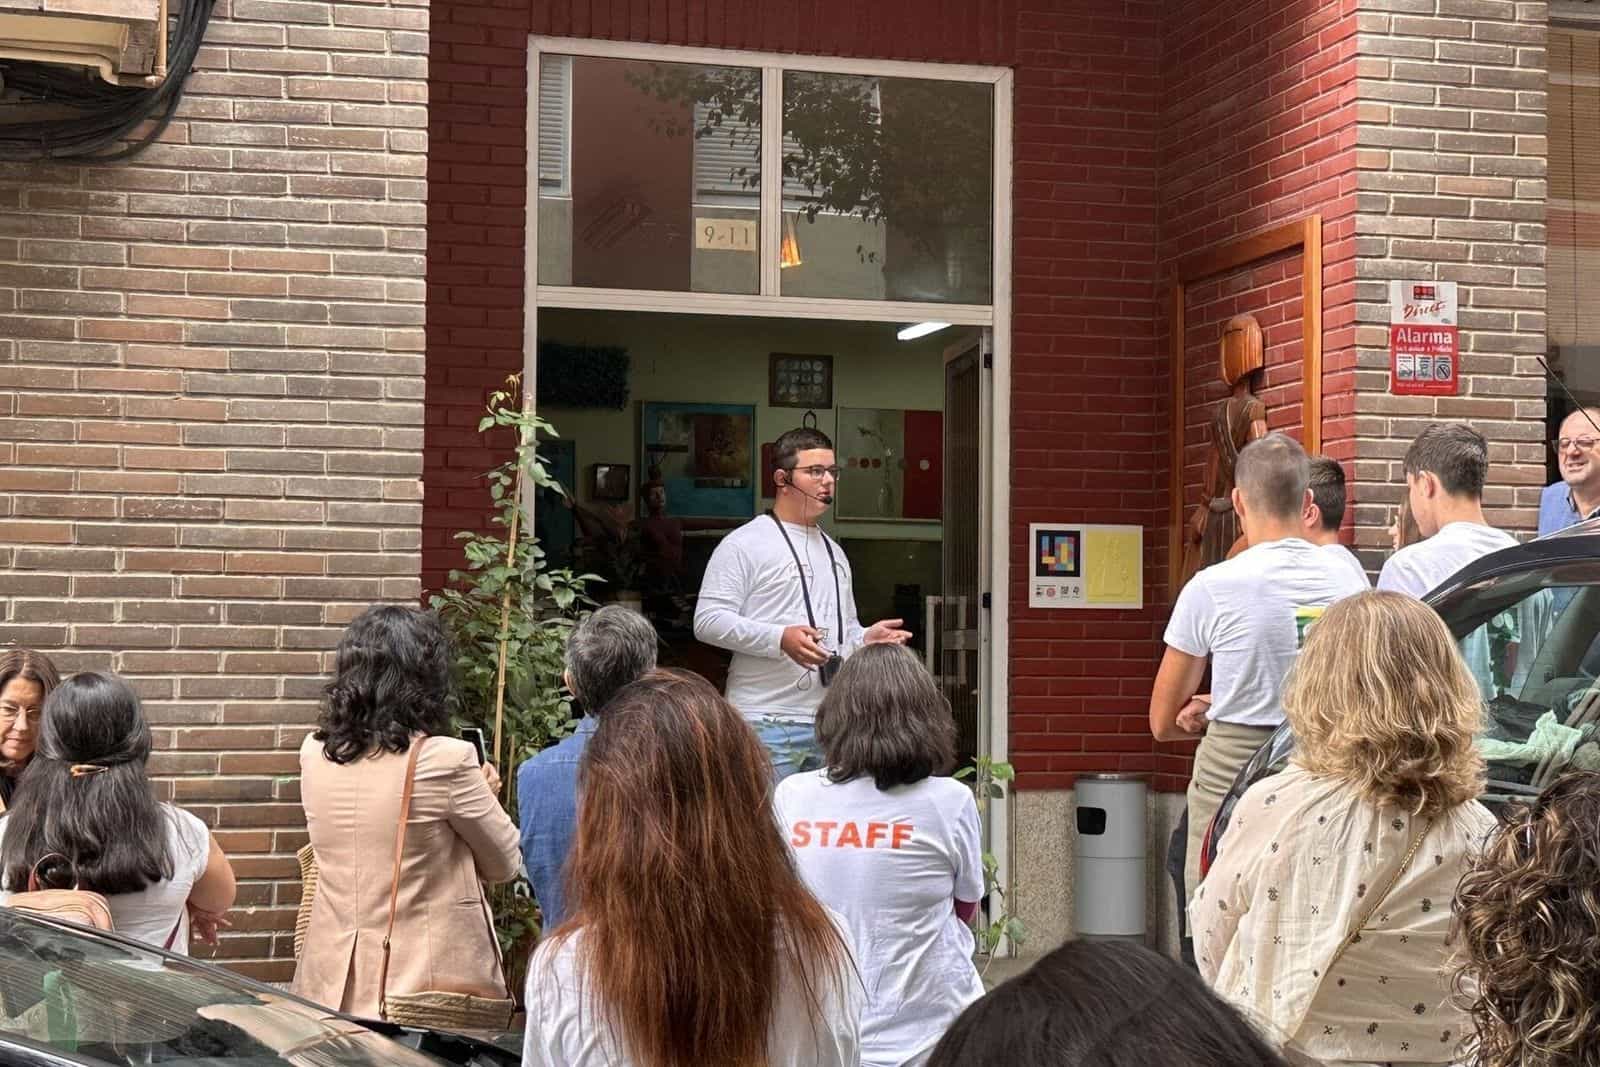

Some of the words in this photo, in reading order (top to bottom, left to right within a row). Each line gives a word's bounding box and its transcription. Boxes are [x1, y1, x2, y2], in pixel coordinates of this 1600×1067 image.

[704, 225, 748, 245] 9-11
[1397, 328, 1452, 344] Alarma
[791, 821, 913, 849] STAFF
